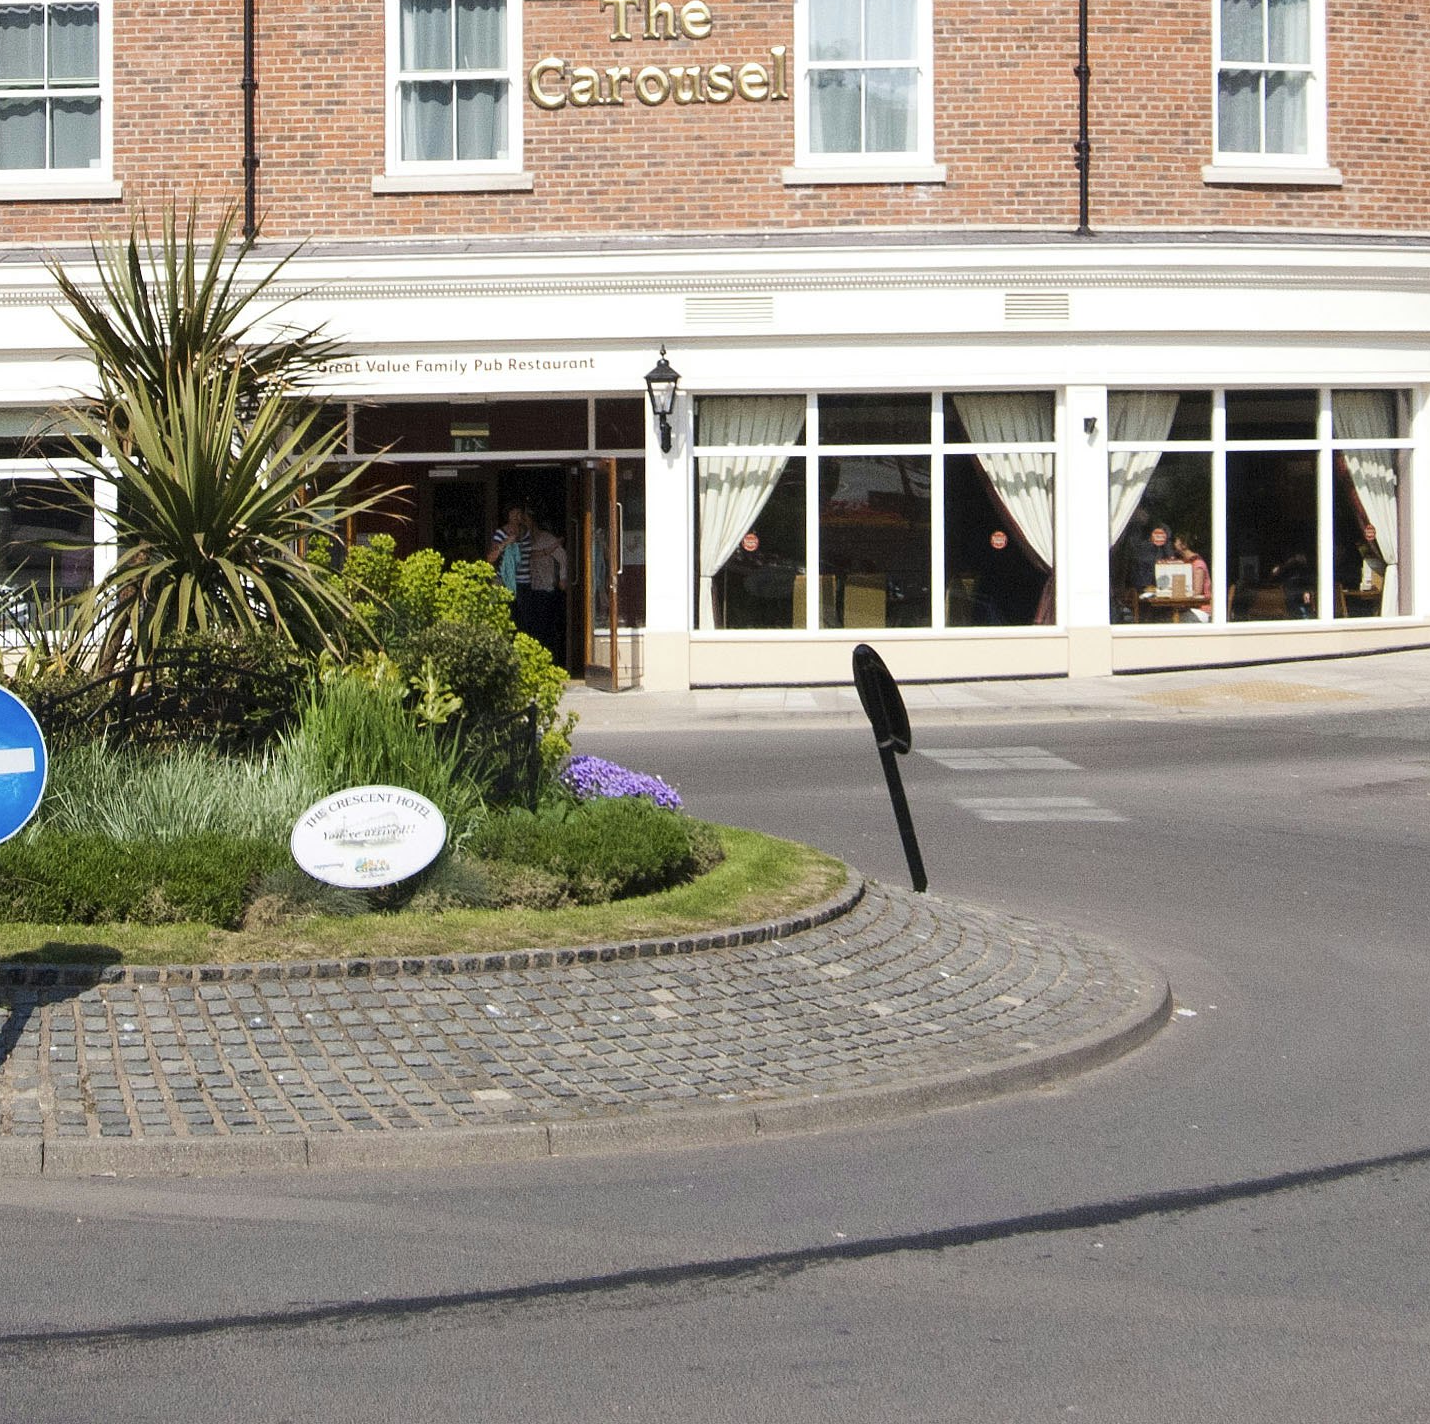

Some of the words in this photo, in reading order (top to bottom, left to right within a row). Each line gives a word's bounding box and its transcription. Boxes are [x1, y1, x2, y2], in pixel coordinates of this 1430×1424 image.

[527, 45, 790, 111] Carousel
[317, 360, 361, 373] Great
[366, 360, 410, 373] Value
[416, 359, 468, 375] Family
[475, 359, 503, 372] Pub
[508, 357, 596, 371] Restaurant
[305, 808, 328, 828] THE
[328, 793, 394, 813] CRESCENT
[396, 795, 431, 820] HOTEL
[323, 828, 362, 841] You've
